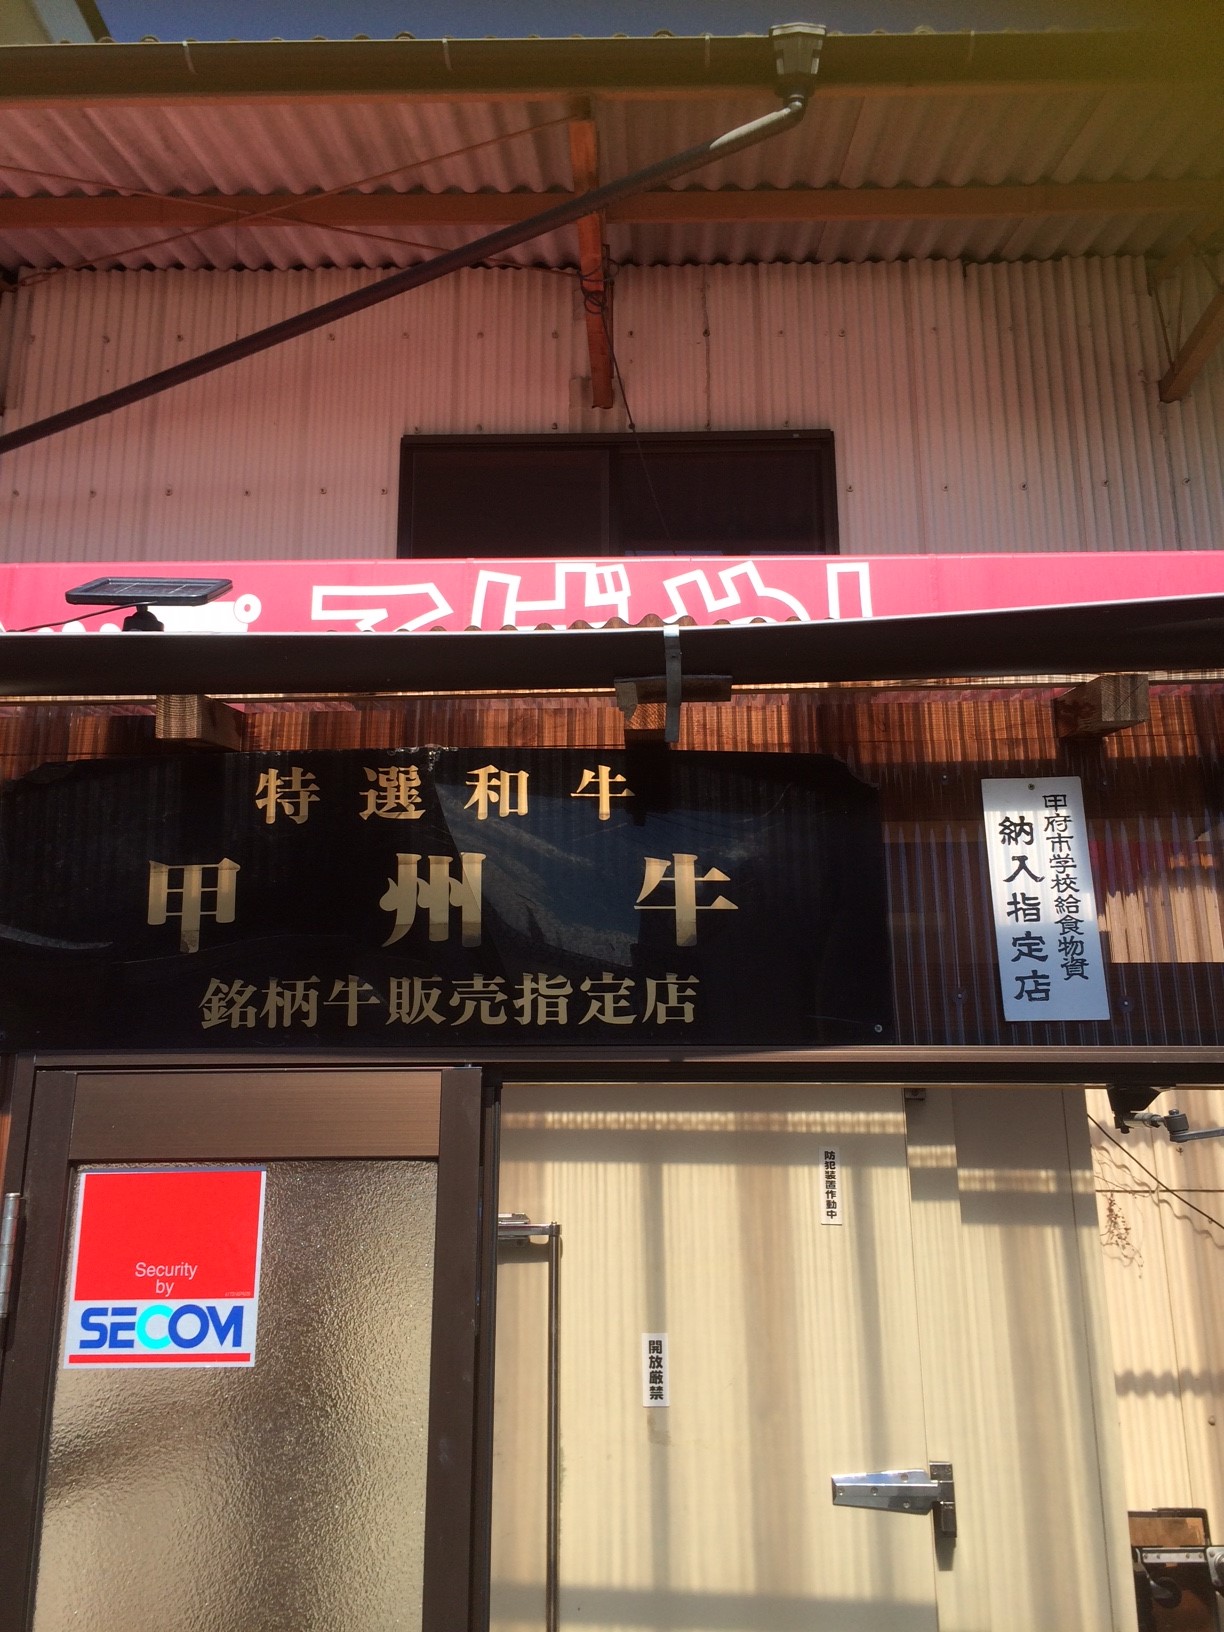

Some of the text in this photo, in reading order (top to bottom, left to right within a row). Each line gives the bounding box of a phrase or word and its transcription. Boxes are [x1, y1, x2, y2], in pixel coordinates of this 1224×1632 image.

[255, 764, 635, 824] 特選和牛
[146, 852, 739, 953] 甲州牛
[998, 815, 1050, 1002] 納入指定店
[1042, 794, 1089, 981] 甲府市学校給食物資
[199, 972, 700, 1028] 銘柄牛販売指定店
[824, 1150, 837, 1219] 防犯装置作動中
[134, 1261, 198, 1280] Security
[155, 1279, 175, 1297] by
[79, 1303, 245, 1350] SECOM
[648, 1339, 664, 1400] 開放厳禁
